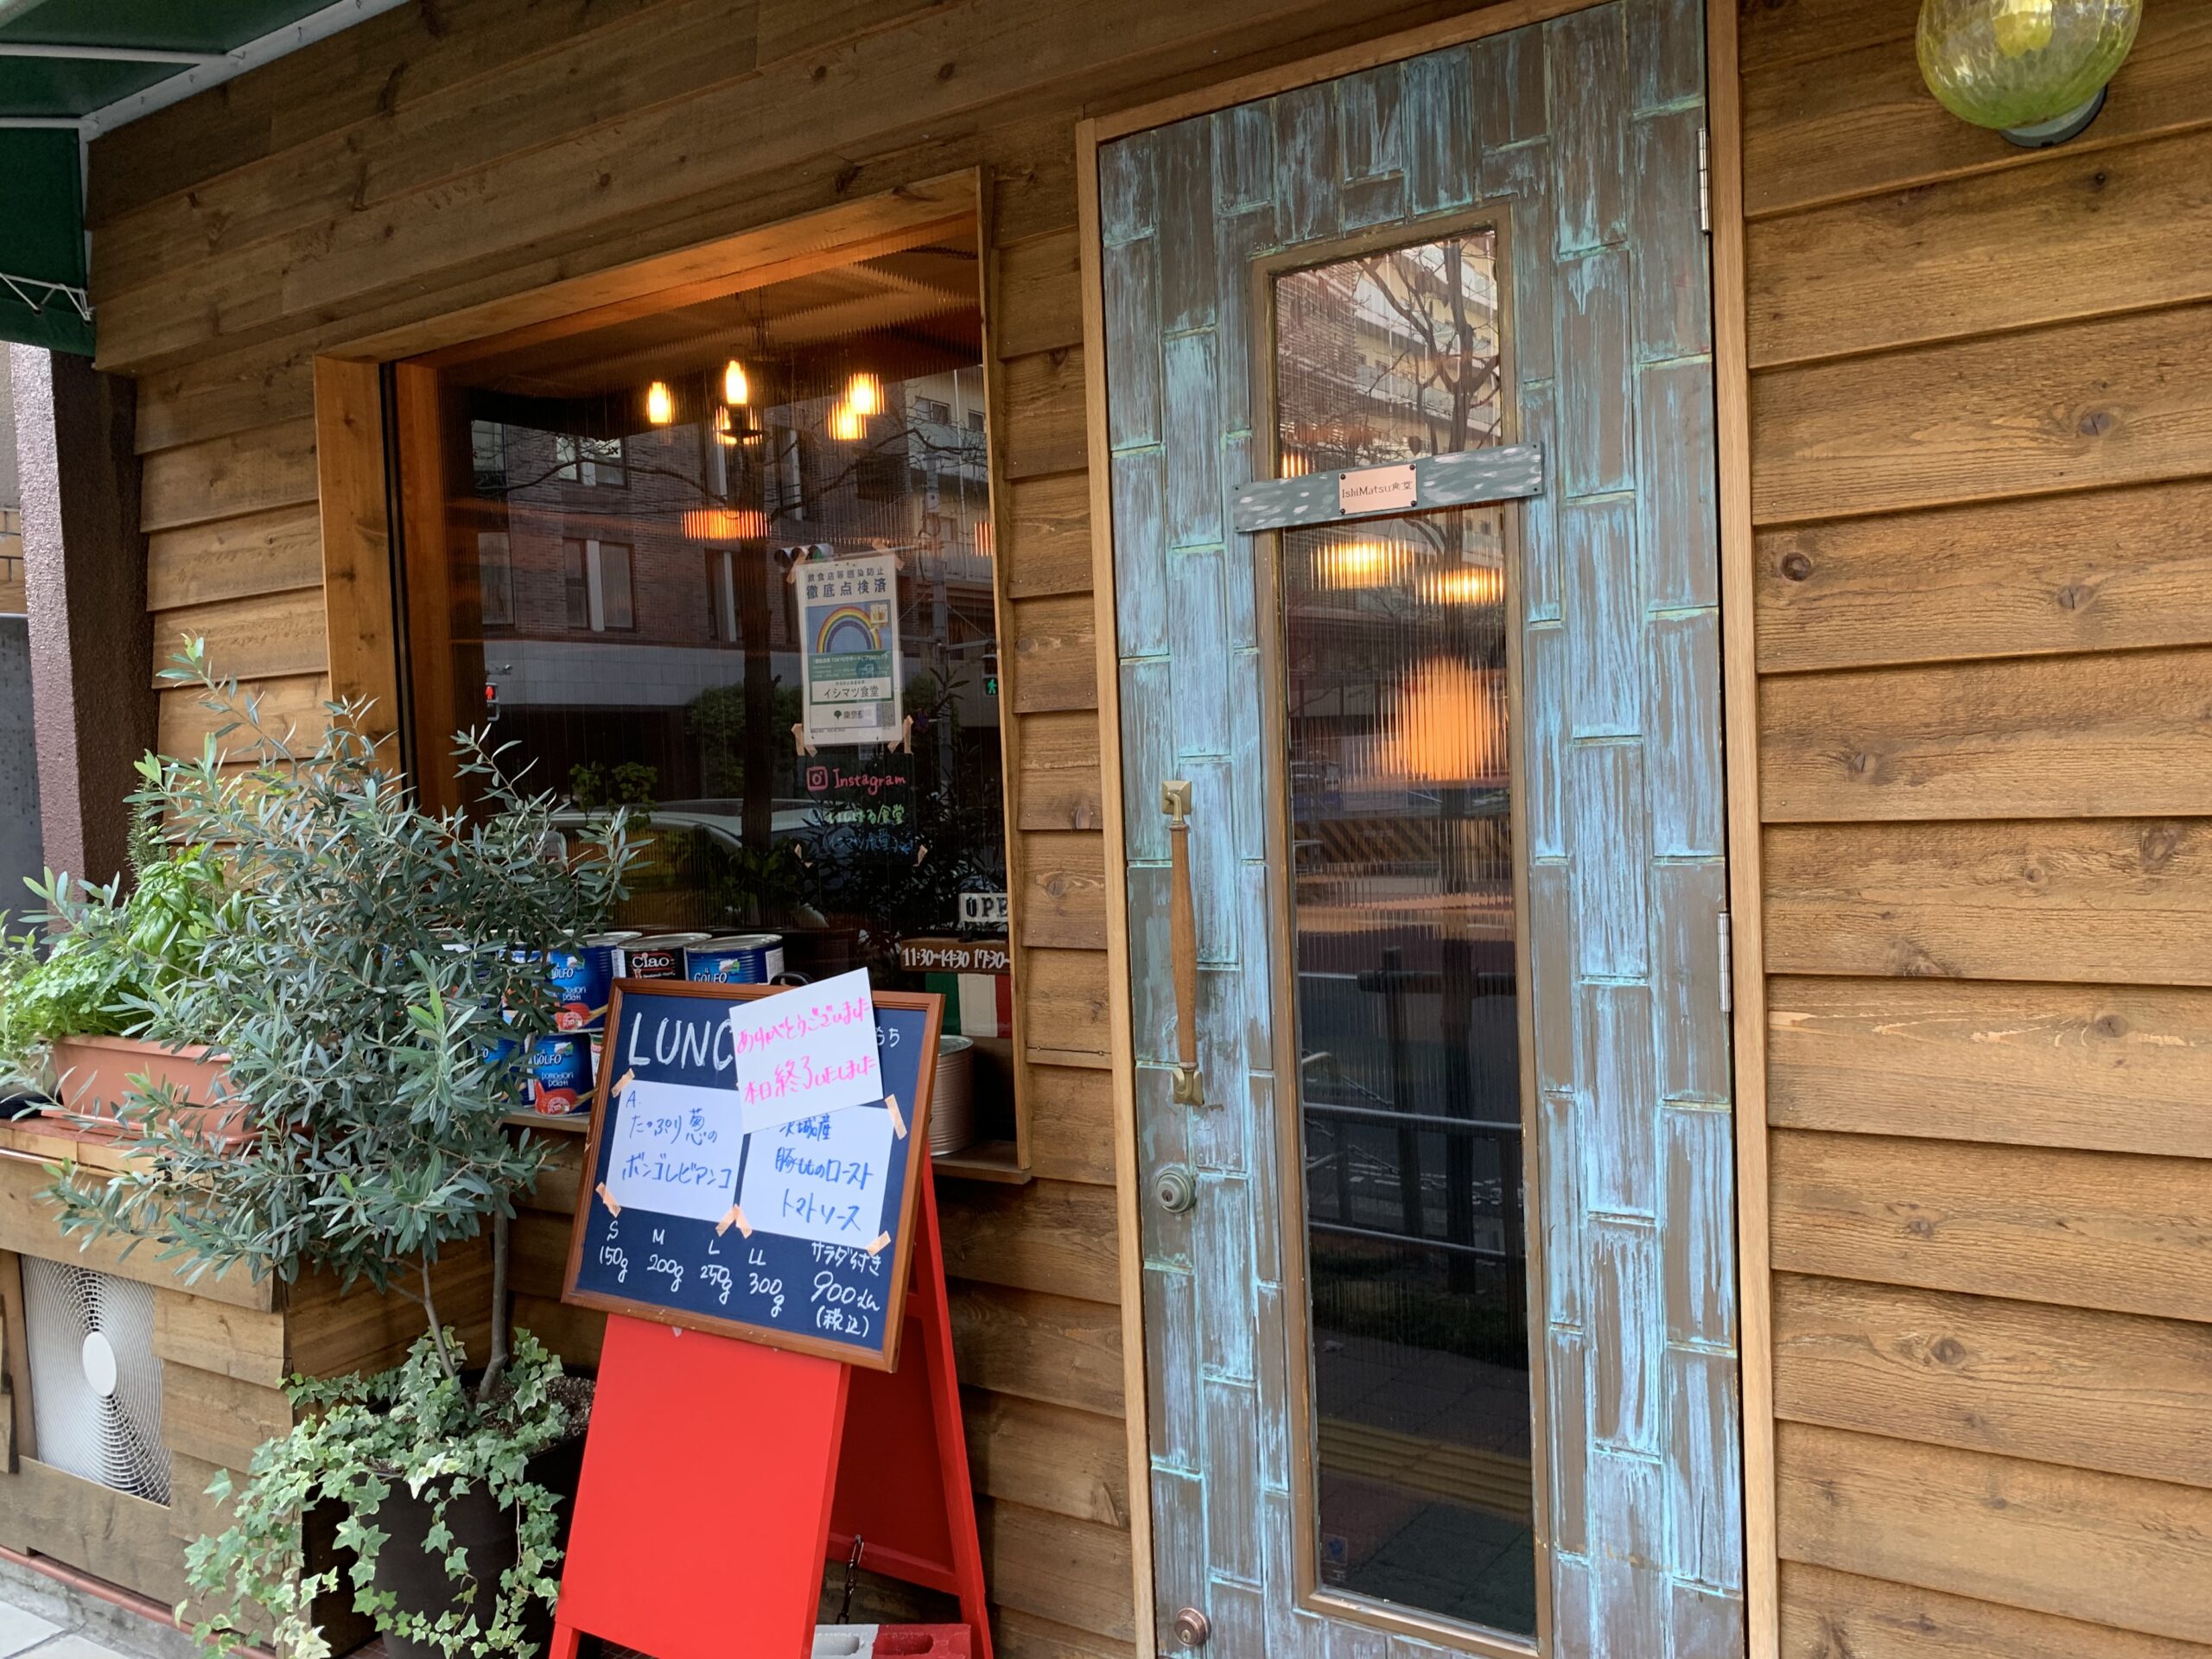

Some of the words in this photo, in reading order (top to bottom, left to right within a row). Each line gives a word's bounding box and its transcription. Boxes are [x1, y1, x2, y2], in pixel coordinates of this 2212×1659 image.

[1342, 480, 1413, 499] IshiMatsu食堂
[806, 577, 887, 600] 徹底点検済
[823, 685, 879, 699] イシマツ食堂
[832, 767, 907, 795] Instagram
[965, 896, 1007, 918] OPE
[550, 968, 574, 979] OLFO
[632, 952, 670, 969] Ciao
[694, 972, 728, 982] GOLFO
[736, 996, 872, 1054] ありがとうございました
[628, 1012, 734, 1071] LUNC
[533, 1054, 563, 1065] GOLFO
[744, 1055, 877, 1105] 本日終了いたしました
[621, 1152, 733, 1189] ボンゴレビアンコ
[774, 1147, 874, 1191] 豚もものロースト
[782, 1188, 861, 1232] トマトソース
[607, 1220, 619, 1241] S
[652, 1229, 665, 1245] M
[708, 1239, 721, 1255] L
[600, 1245, 628, 1283] 150g
[646, 1254, 684, 1293] 200g
[700, 1264, 733, 1305] 250g
[811, 1242, 882, 1277] サラダ付き
[817, 1306, 869, 1338] (税込)
